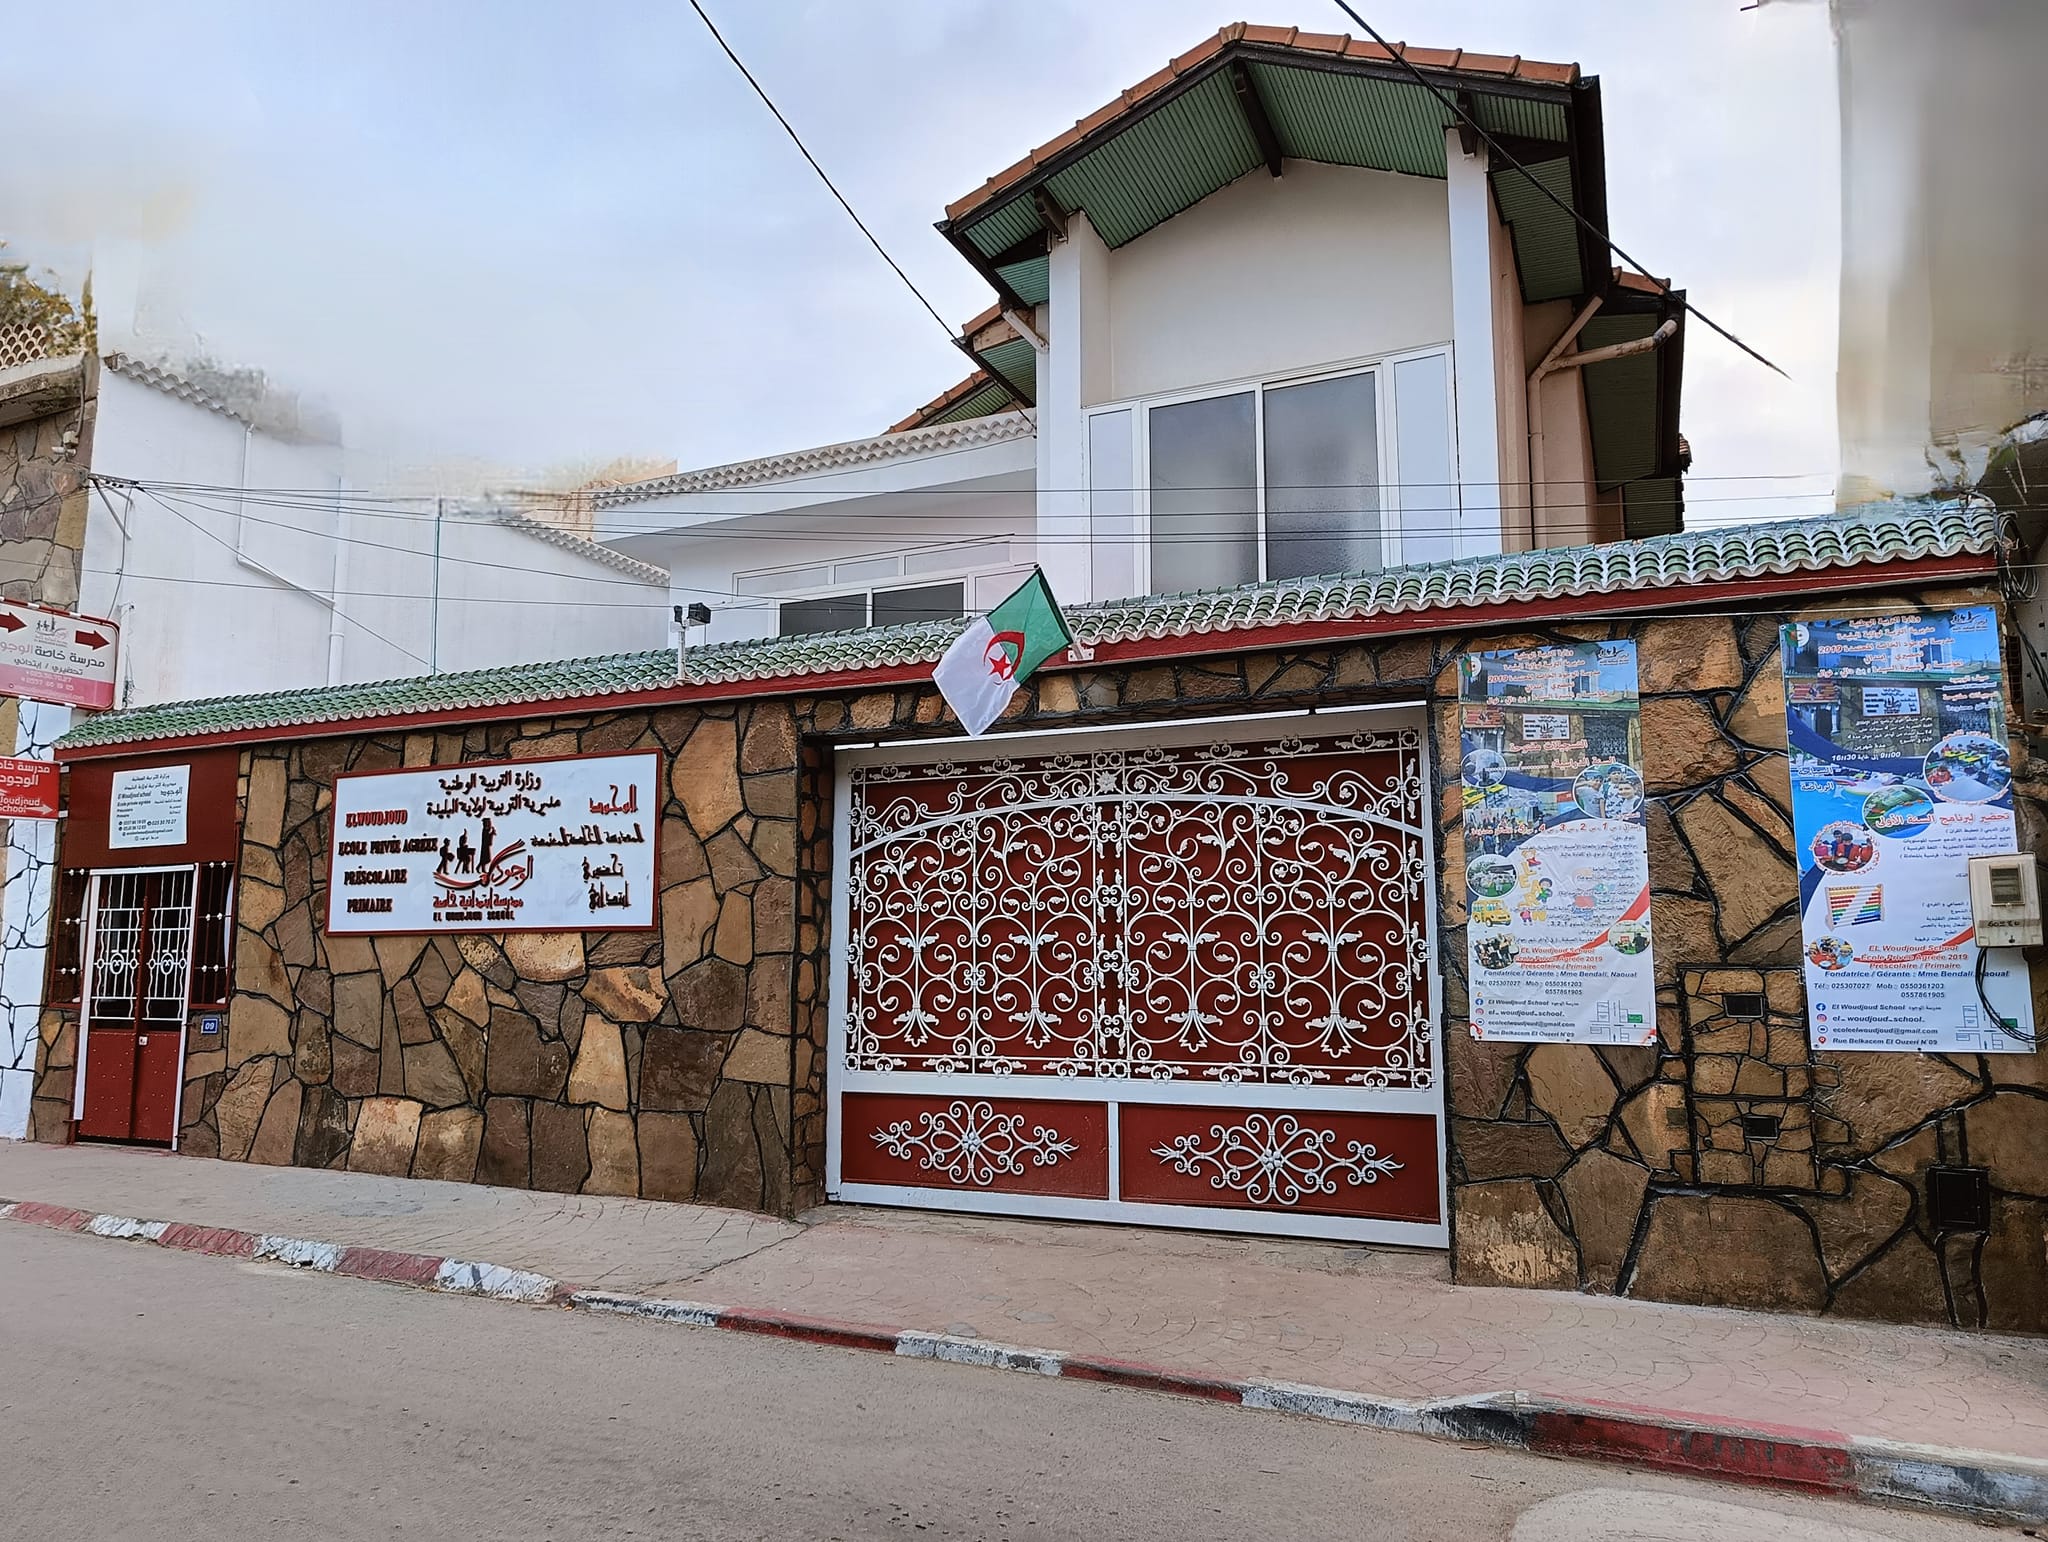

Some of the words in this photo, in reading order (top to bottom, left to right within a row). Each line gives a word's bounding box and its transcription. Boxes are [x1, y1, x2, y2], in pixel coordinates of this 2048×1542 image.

[0, 641, 34, 655] الوجو
[35, 646, 66, 660] خاصة
[1817, 645, 1842, 655] 2019
[69, 652, 105, 668] مدرسة
[52, 665, 84, 676] تحضيري
[1509, 742, 1541, 754] مفتوحة
[1543, 738, 1589, 752] التسجيلات
[1591, 755, 1616, 765] السنة
[17, 761, 50, 774] مدرسة
[438, 772, 477, 795] الوطنية
[478, 770, 512, 793] التربية
[514, 770, 542, 791] وزارة
[1801, 781, 1835, 793] الرياضة
[487, 794, 522, 816] التربية
[523, 795, 561, 817] مديرية
[588, 783, 639, 816] الوجود
[426, 798, 459, 819] البليدة
[458, 796, 487, 818] لولاية
[1875, 813, 1904, 829] الأولى
[1908, 814, 1935, 824] السنة
[1940, 813, 1975, 826] لبرنامج
[1981, 812, 2010, 823] تحضير
[603, 822, 645, 845] المدرسة
[338, 841, 368, 857] ECOLE
[344, 865, 408, 886] PRÉSCOLAIRE
[491, 855, 534, 892] الوجود
[581, 853, 625, 884] تحضيري
[347, 898, 393, 913] PRIMAIRE
[432, 889, 457, 908] خاصة
[494, 893, 524, 910] مدرسة
[433, 912, 442, 922] EL
[445, 911, 483, 921] WOUDJOUD
[486, 910, 515, 921] SCHOOL
[1882, 945, 1927, 953] Woudjoud
[1978, 970, 2010, 978] aoual
[1841, 1003, 1879, 1012] Woudjoud
[205, 1022, 215, 1030] 09
[1832, 1026, 1938, 1036] ecoleelwoudjoud@gmail.com
